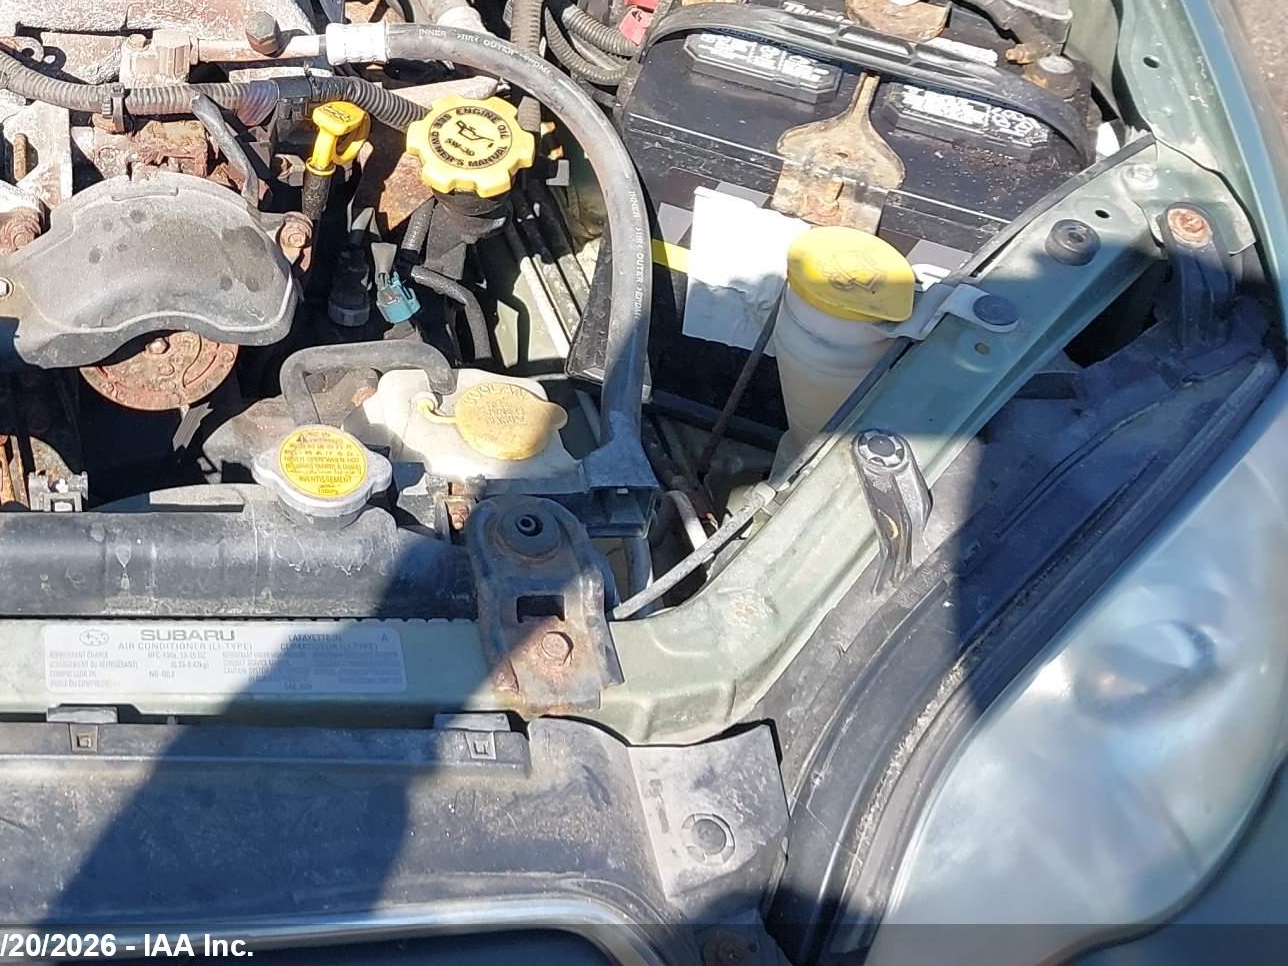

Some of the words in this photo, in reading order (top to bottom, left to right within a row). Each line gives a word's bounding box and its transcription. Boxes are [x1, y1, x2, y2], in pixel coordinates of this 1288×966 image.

[418, 28, 447, 37] INNER
[483, 39, 514, 55] OUTER
[456, 107, 503, 124] ENGINE
[497, 124, 510, 139] OIL
[432, 131, 465, 166] OWNER'S
[468, 145, 508, 167] MANUAL
[636, 252, 644, 283] OUTER
[138, 642, 206, 650] CONDITIONER
[140, 629, 235, 641] SUBARU
